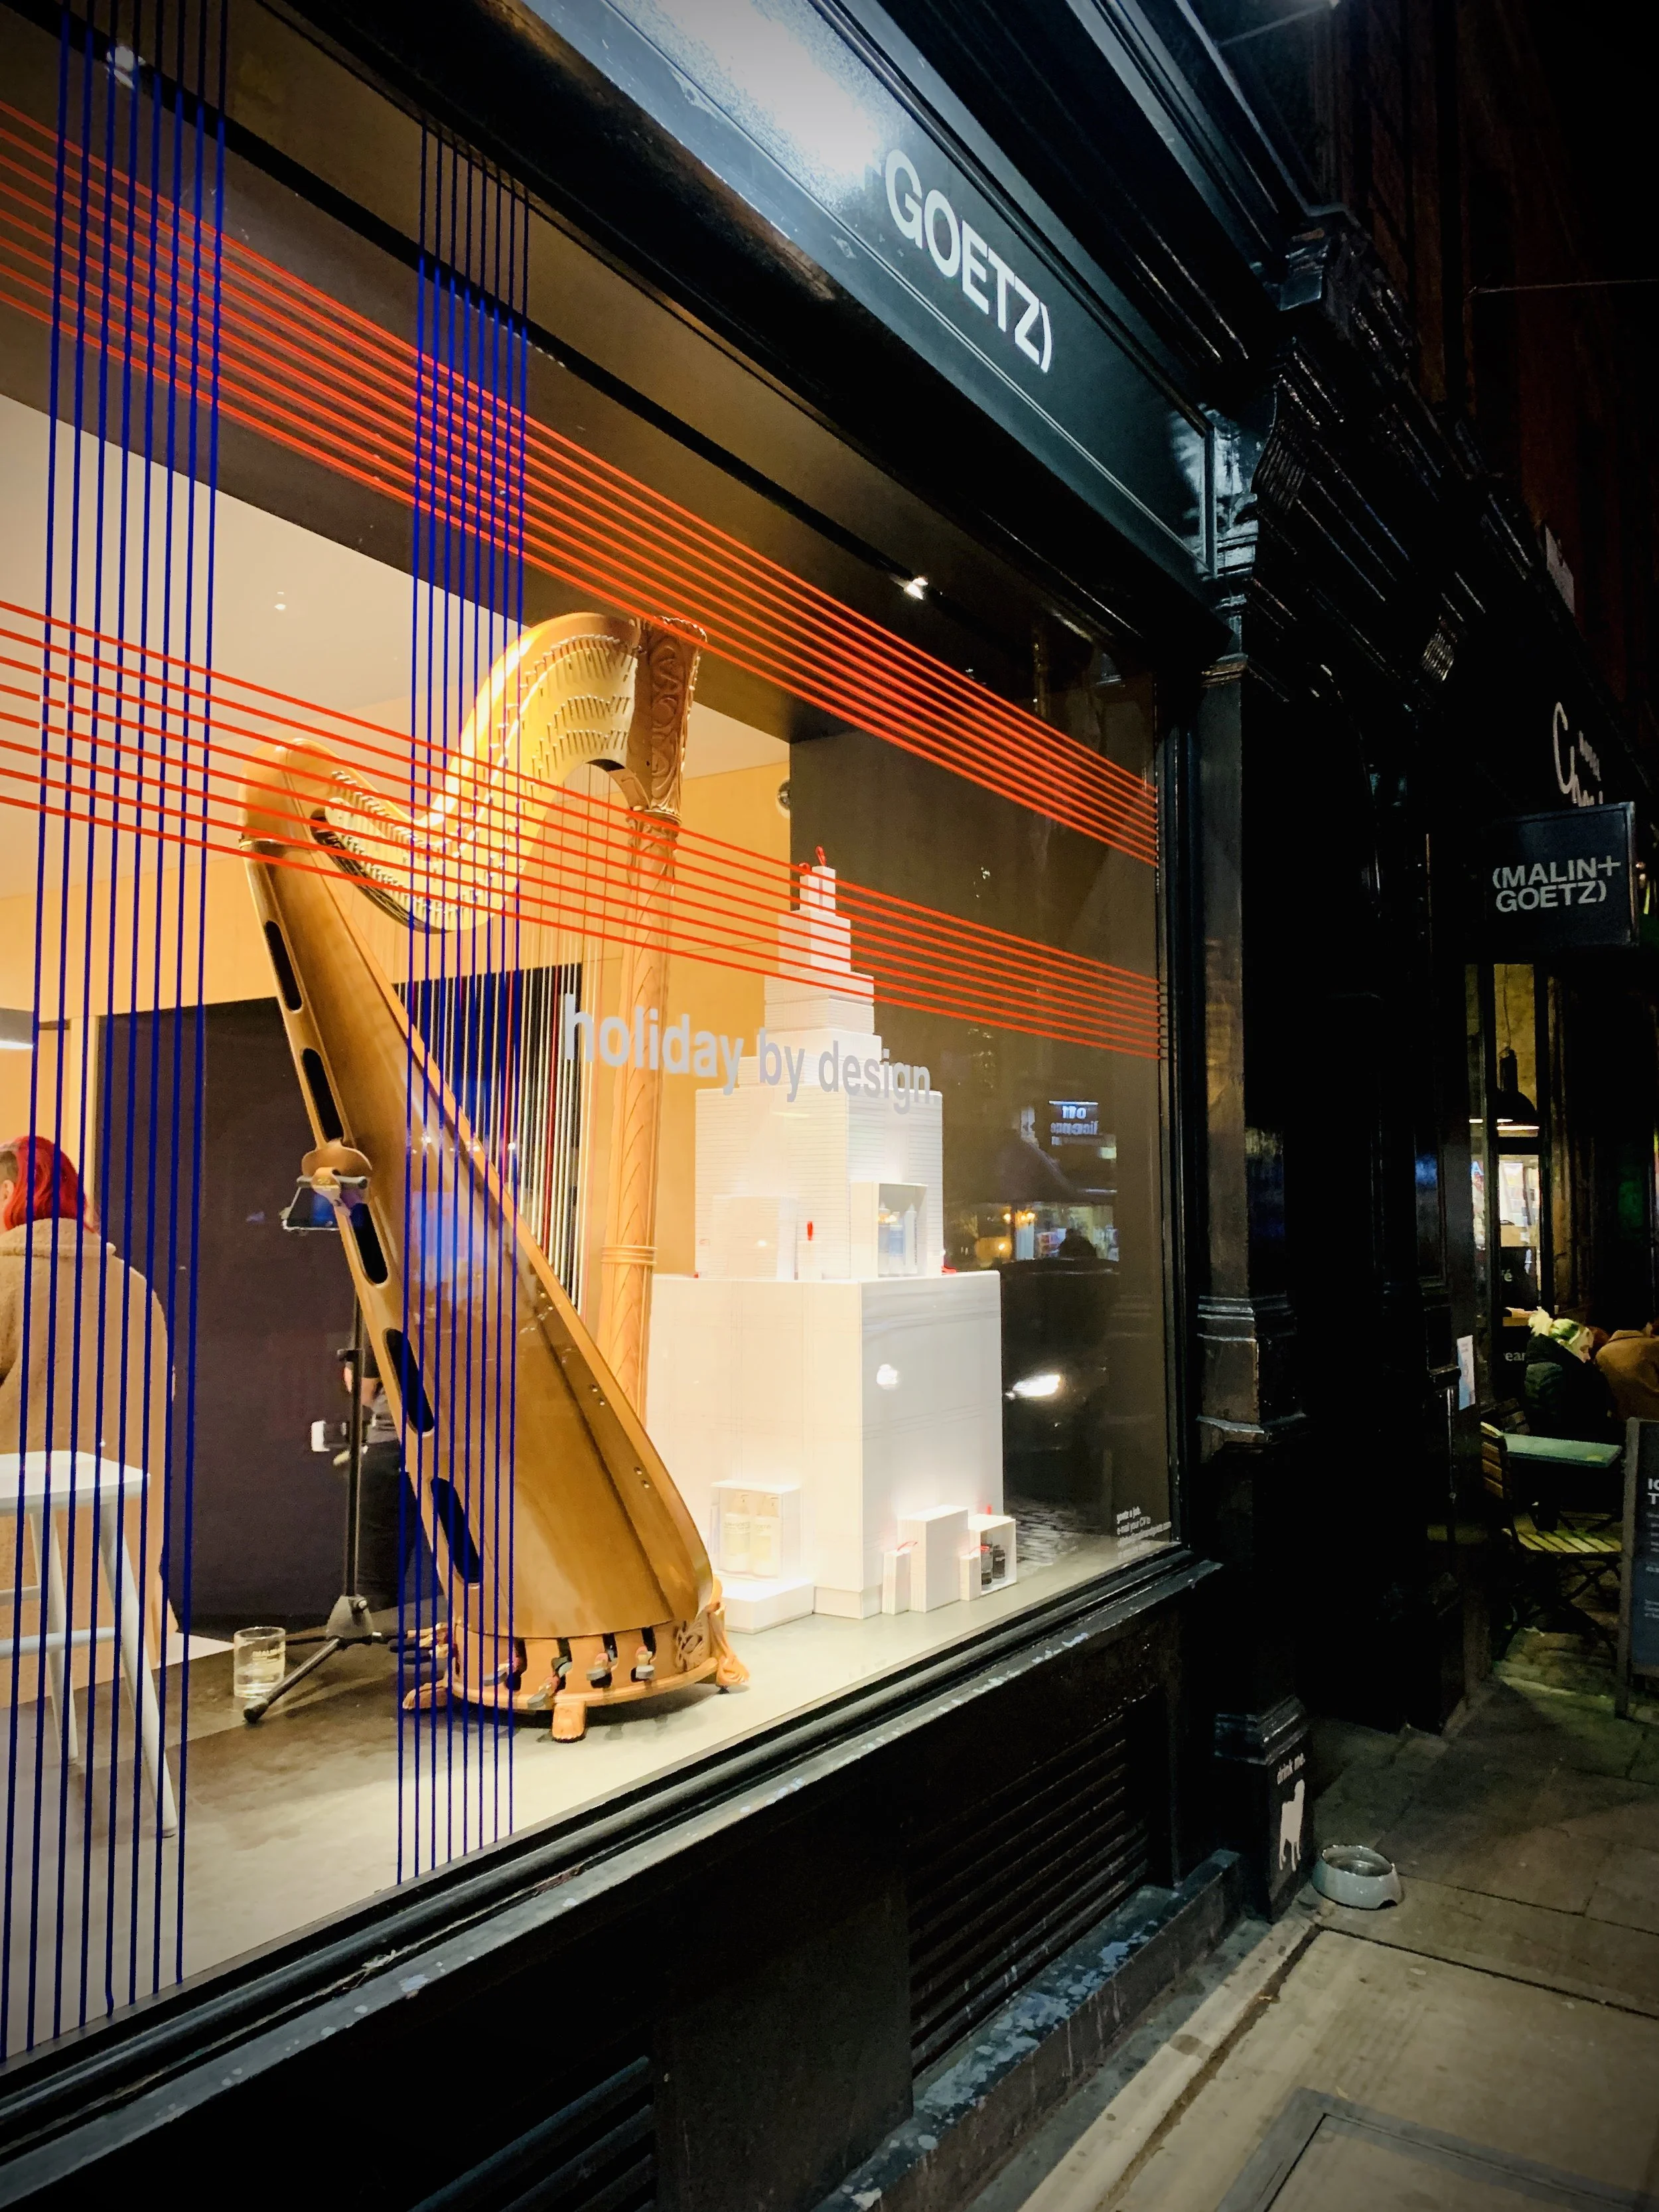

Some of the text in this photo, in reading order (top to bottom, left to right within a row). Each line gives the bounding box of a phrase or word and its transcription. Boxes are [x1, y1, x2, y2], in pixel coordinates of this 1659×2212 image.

[885, 149, 1052, 373] GOETZ)
[1492, 855, 1621, 889] (MALIN+
[1495, 879, 1607, 913] GOETZ)
[564, 993, 745, 1096] holiday
[758, 1027, 806, 1103] by
